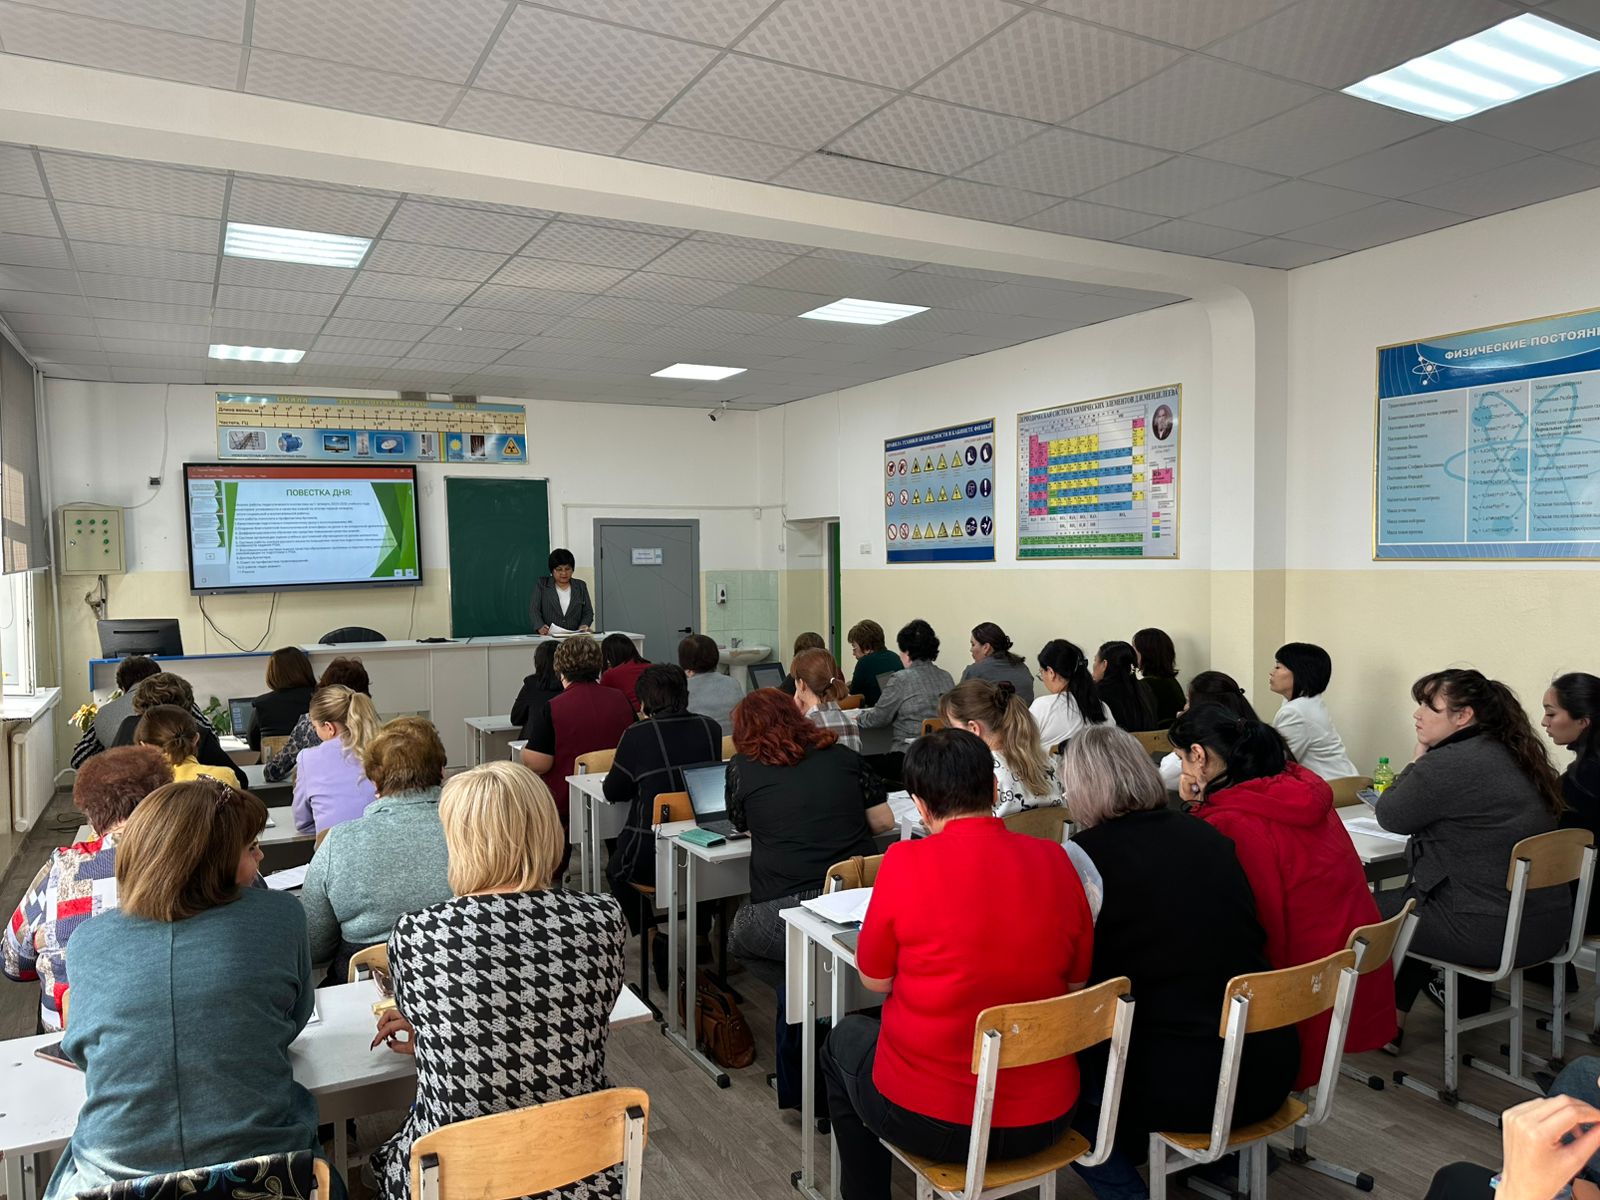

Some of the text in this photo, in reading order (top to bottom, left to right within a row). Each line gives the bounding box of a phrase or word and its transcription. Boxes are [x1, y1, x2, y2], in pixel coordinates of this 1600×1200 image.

[1444, 339, 1527, 360] ФИЗИЧЕСКИЕ
[286, 488, 353, 498] ПОВЕСТКА ДНЯ:
